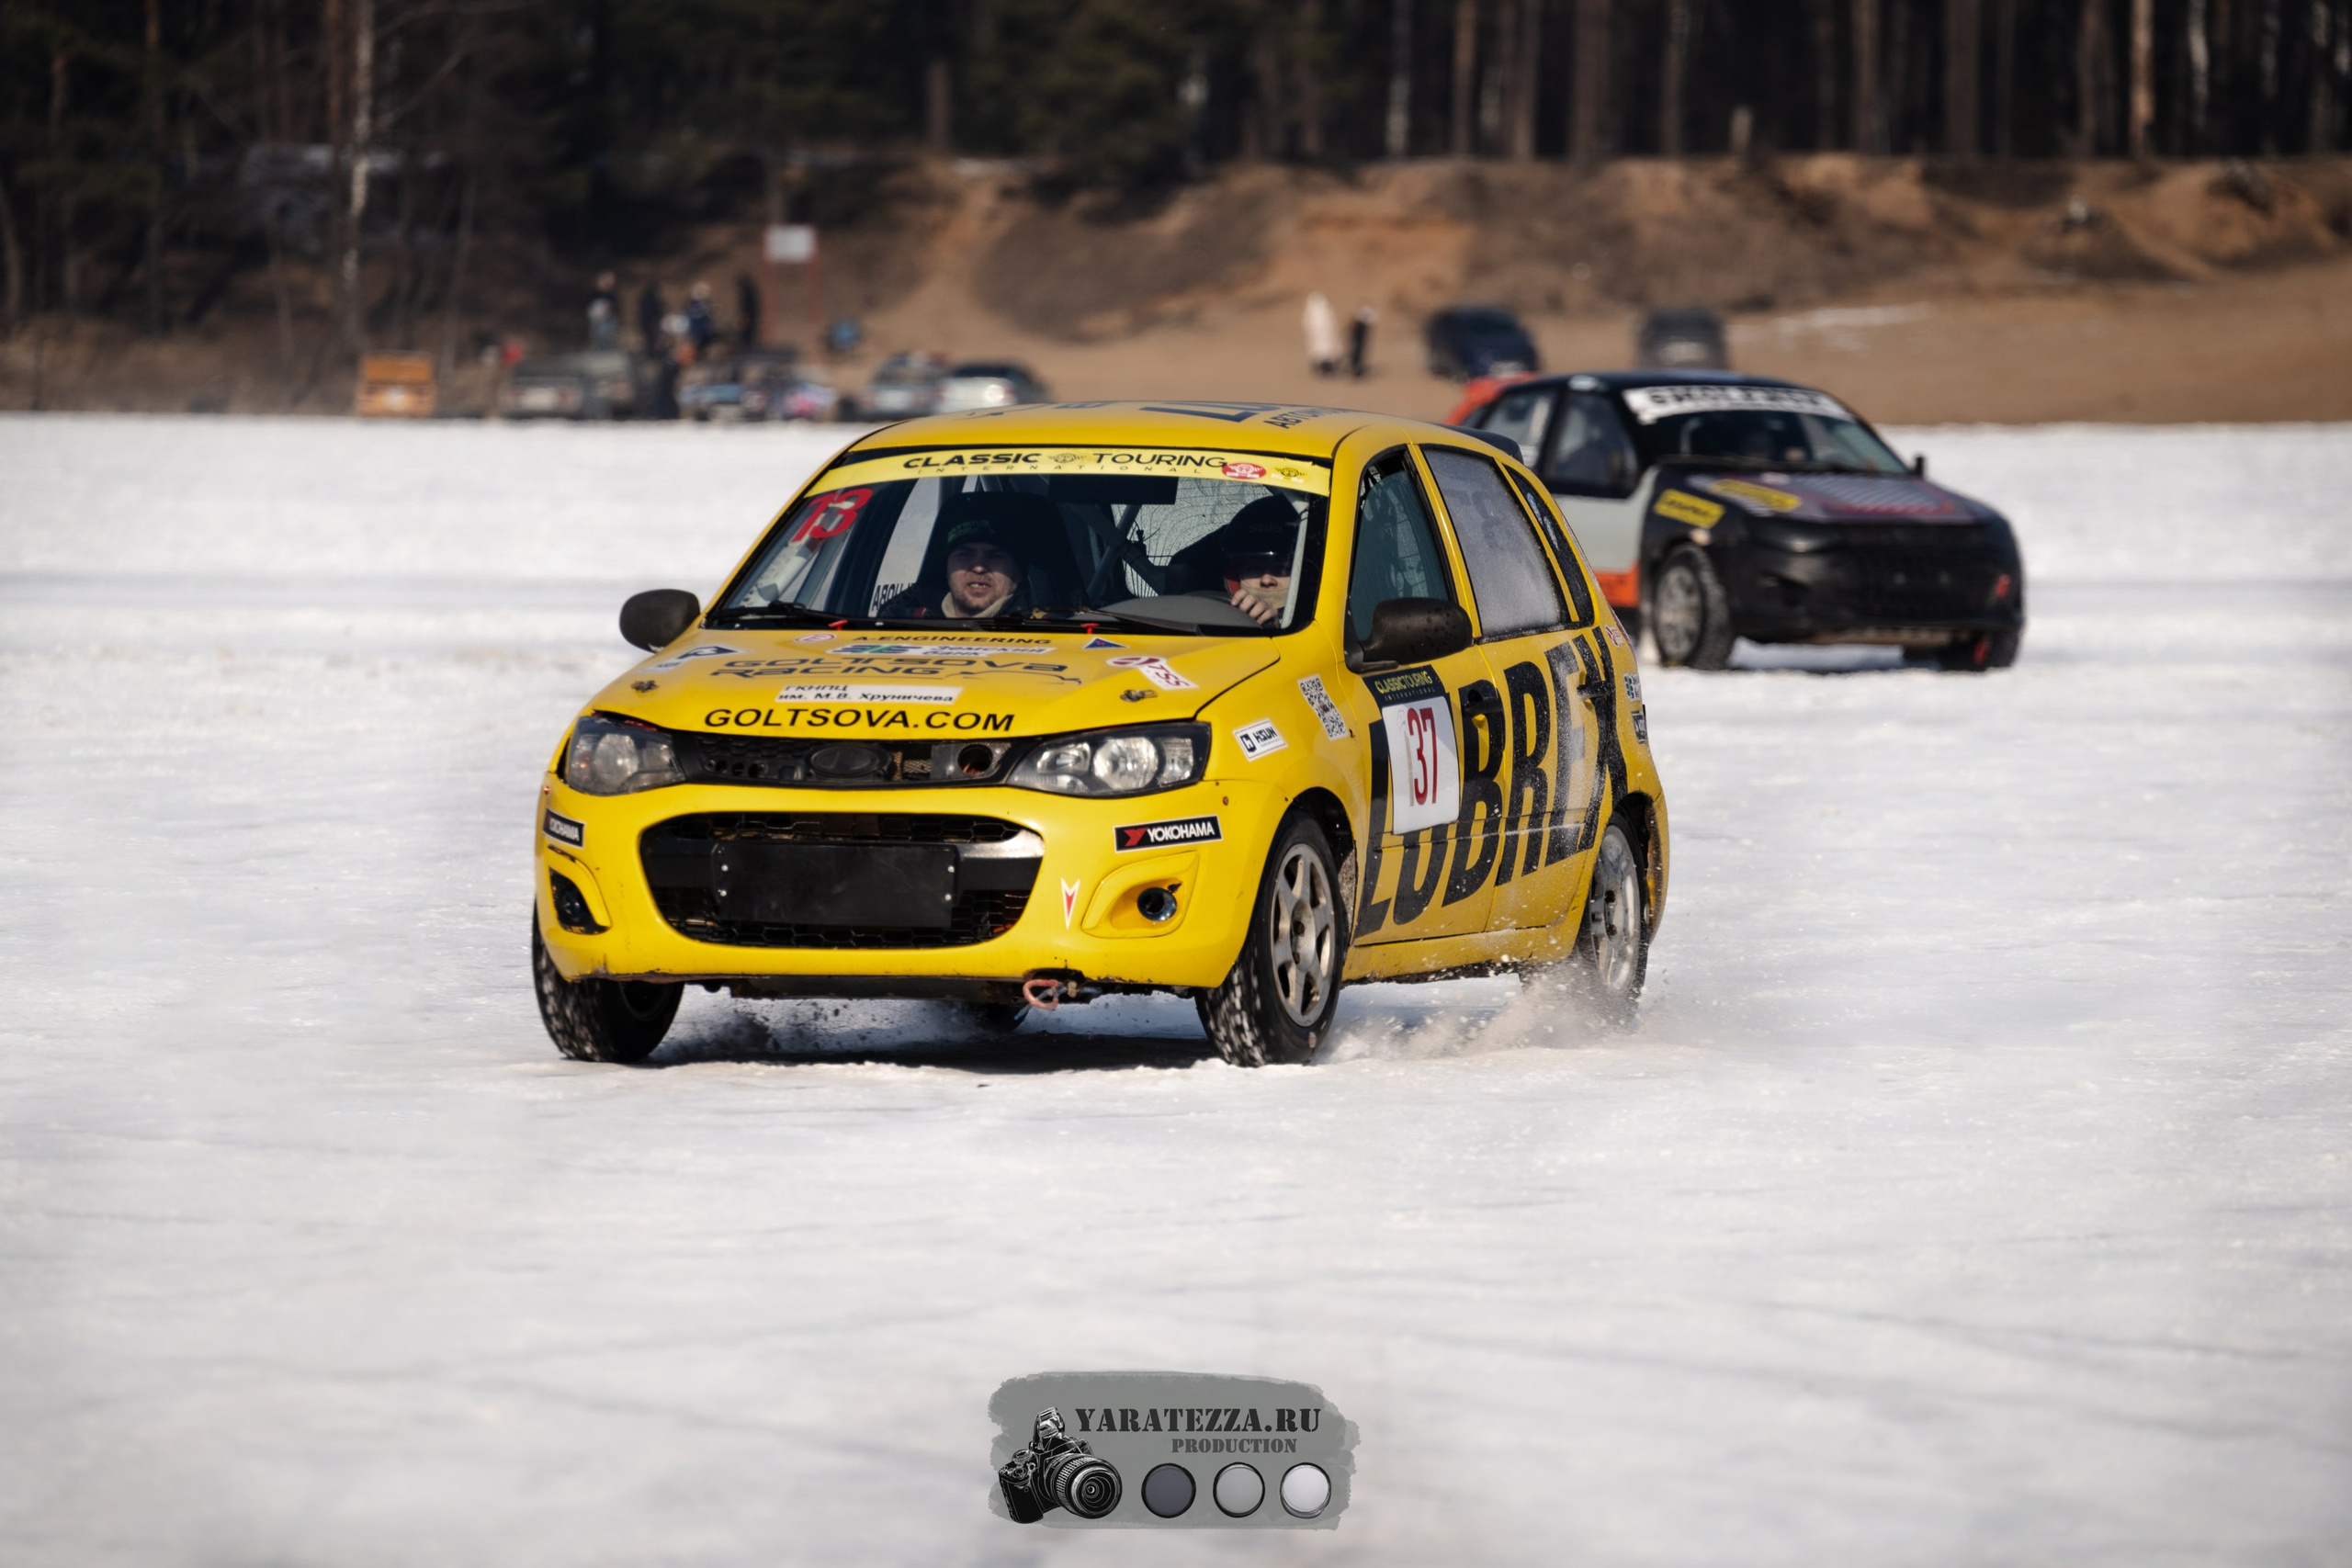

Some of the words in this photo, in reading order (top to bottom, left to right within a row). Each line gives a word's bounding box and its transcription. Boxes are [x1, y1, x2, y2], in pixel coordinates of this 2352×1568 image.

[902, 453, 1043, 469] CLASSIC
[1092, 453, 1227, 468] TOURING
[917, 464, 1202, 475] INTERNATIONAL
[791, 488, 873, 543] 13
[859, 693, 954, 703] Хруничева
[1385, 688, 1435, 702] INTERNATIONAL
[704, 708, 1015, 732] GOLTSOVA.COM
[1407, 706, 1438, 807] 37
[1147, 821, 1216, 842] YOKOHAMA
